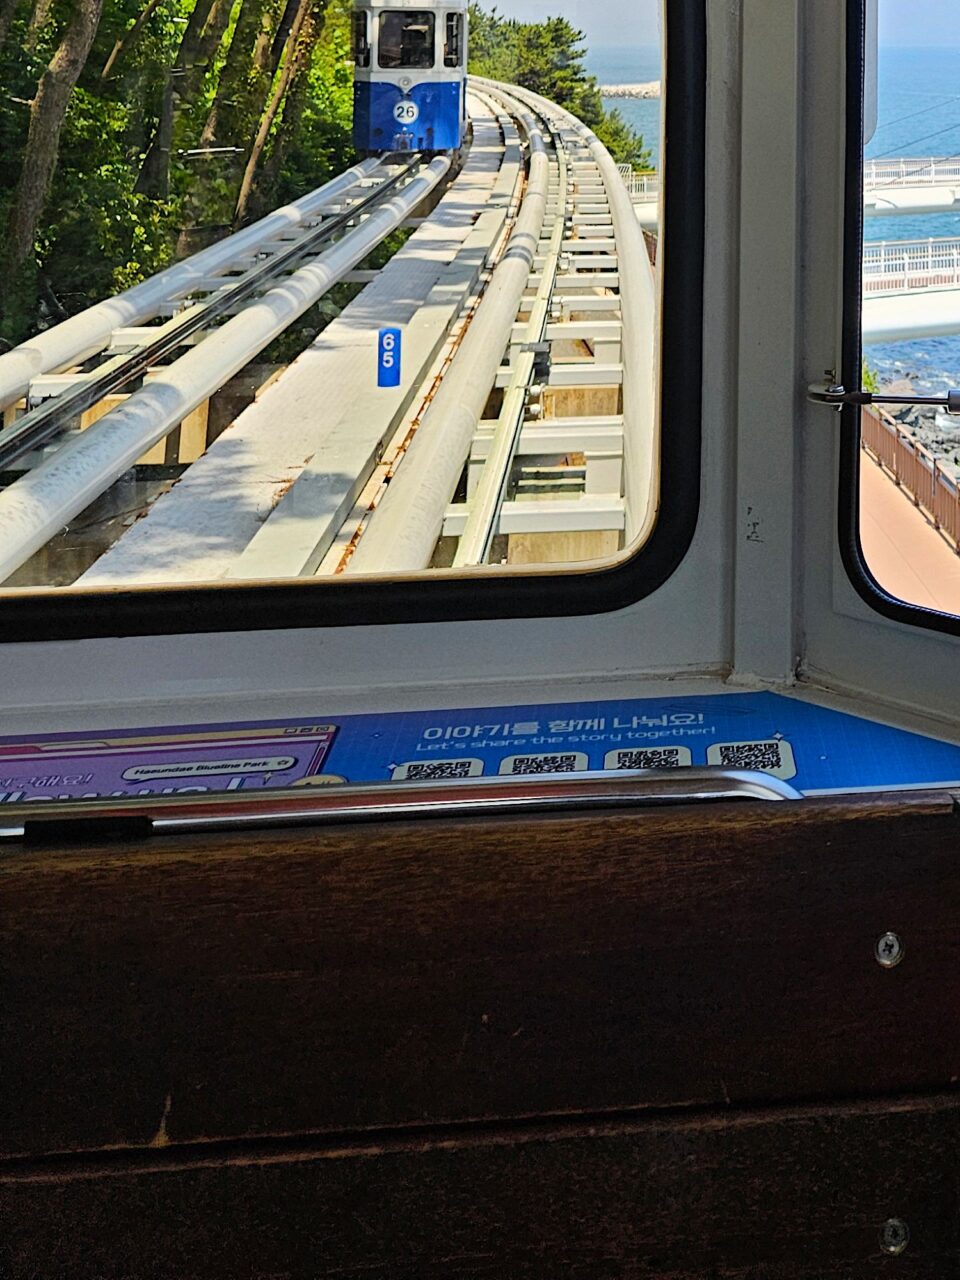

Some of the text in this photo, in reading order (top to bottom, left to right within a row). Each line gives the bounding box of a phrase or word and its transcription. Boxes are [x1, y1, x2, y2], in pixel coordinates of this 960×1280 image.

[396, 105, 415, 119] 26
[423, 721, 541, 740] 이야기를
[548, 718, 605, 733] 함께
[416, 726, 716, 751] Let's share the story together!
[243, 760, 269, 769] Park
